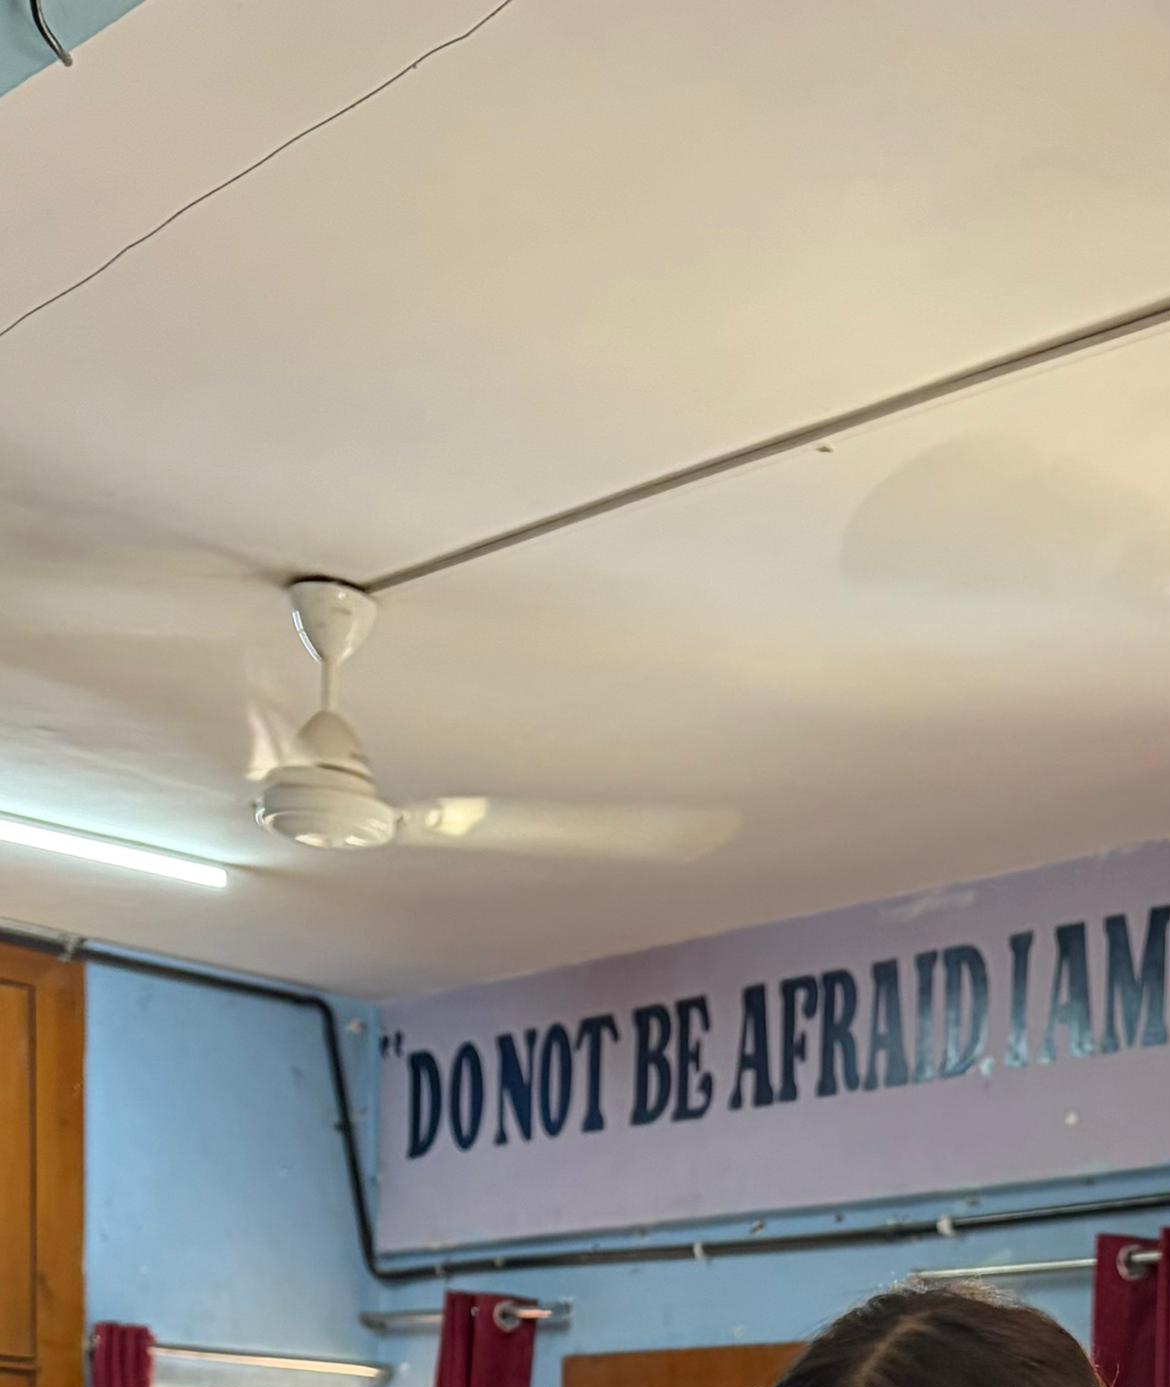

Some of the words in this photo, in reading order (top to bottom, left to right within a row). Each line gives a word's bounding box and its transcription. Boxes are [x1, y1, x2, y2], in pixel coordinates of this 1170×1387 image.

[494, 1012, 620, 1146] NOT
[630, 994, 714, 1127] BE
[1003, 930, 1035, 1069] I
